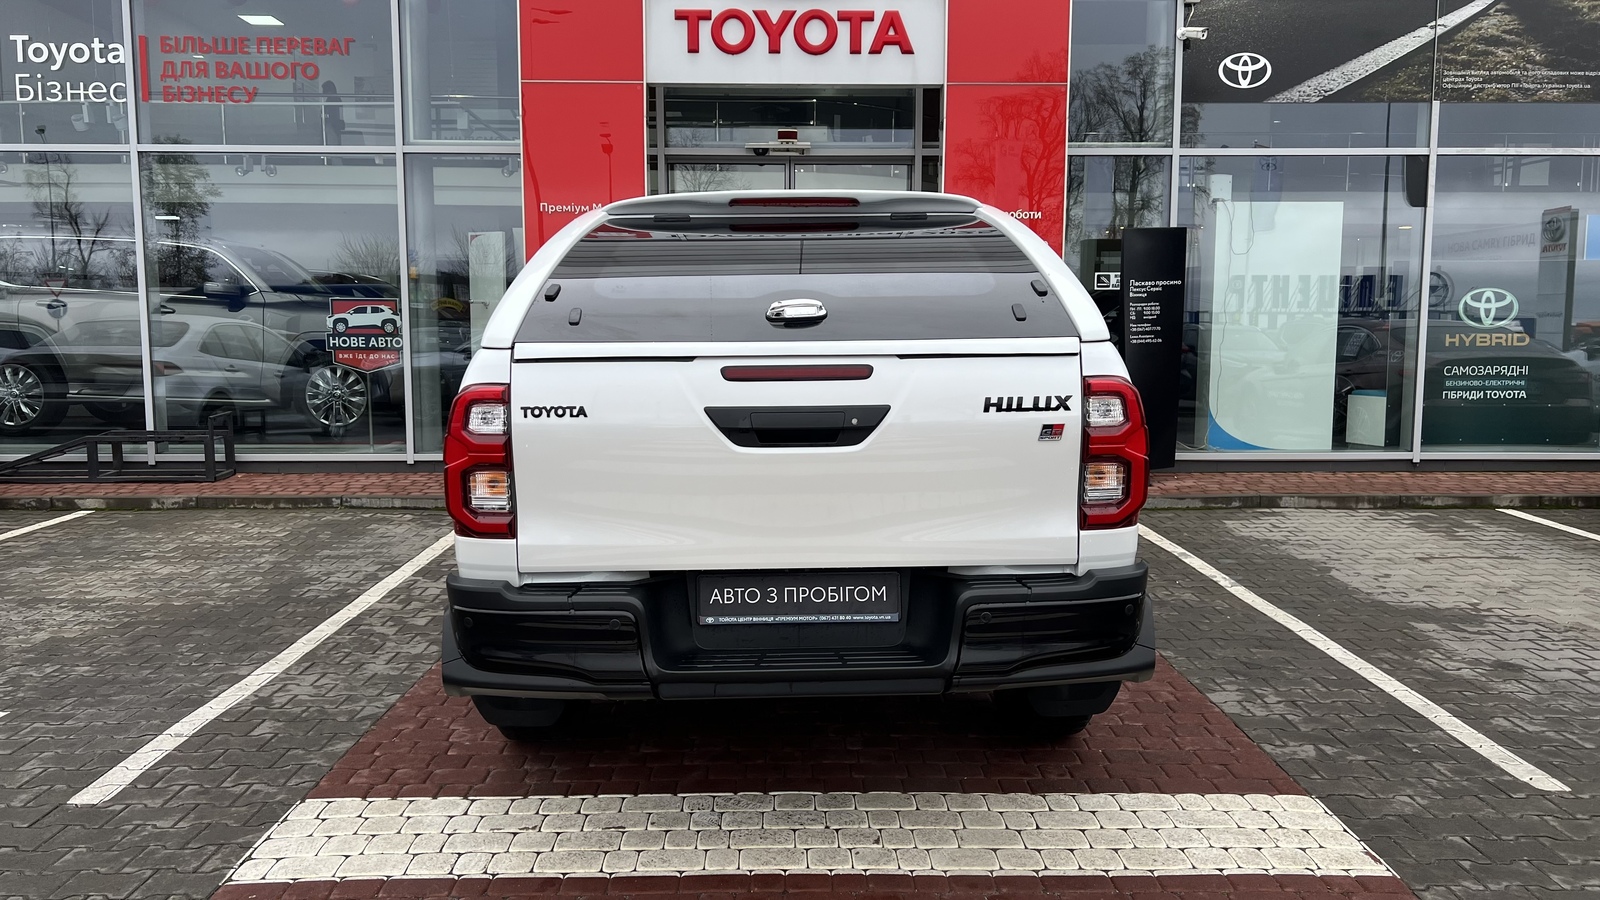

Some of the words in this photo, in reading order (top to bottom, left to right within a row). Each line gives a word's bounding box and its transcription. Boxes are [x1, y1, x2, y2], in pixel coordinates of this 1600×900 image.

[674, 8, 914, 55] TOYOTA
[10, 35, 125, 70] Toyota
[160, 36, 249, 55] БІЛЬШЕ
[256, 37, 355, 56] ПЕРЕВАГ
[160, 61, 208, 81] ДЛЯ
[215, 61, 319, 81] ВАШОГО
[14, 74, 127, 103] Бізнес
[162, 86, 257, 104] БІЗНЕСУ
[540, 202, 589, 214] Преміум
[1004, 209, 1042, 219] оботи
[1503, 232, 1536, 248] ГІБРИД
[1155, 279, 1182, 287] просимо
[330, 336, 366, 348] НОВЕ
[368, 336, 403, 348] АВТО
[1445, 333, 1530, 347] HYBRID
[1443, 365, 1529, 377] САМОЗАРЯДНІ
[1442, 390, 1484, 400] ГІБРИДИ
[1485, 390, 1527, 399] TOYOTA
[520, 405, 588, 418] TOYOTA
[983, 394, 1073, 413] HILUX
[709, 587, 761, 604] АВТО
[766, 587, 778, 603] З
[784, 585, 887, 603] ПРОБІГОМ
